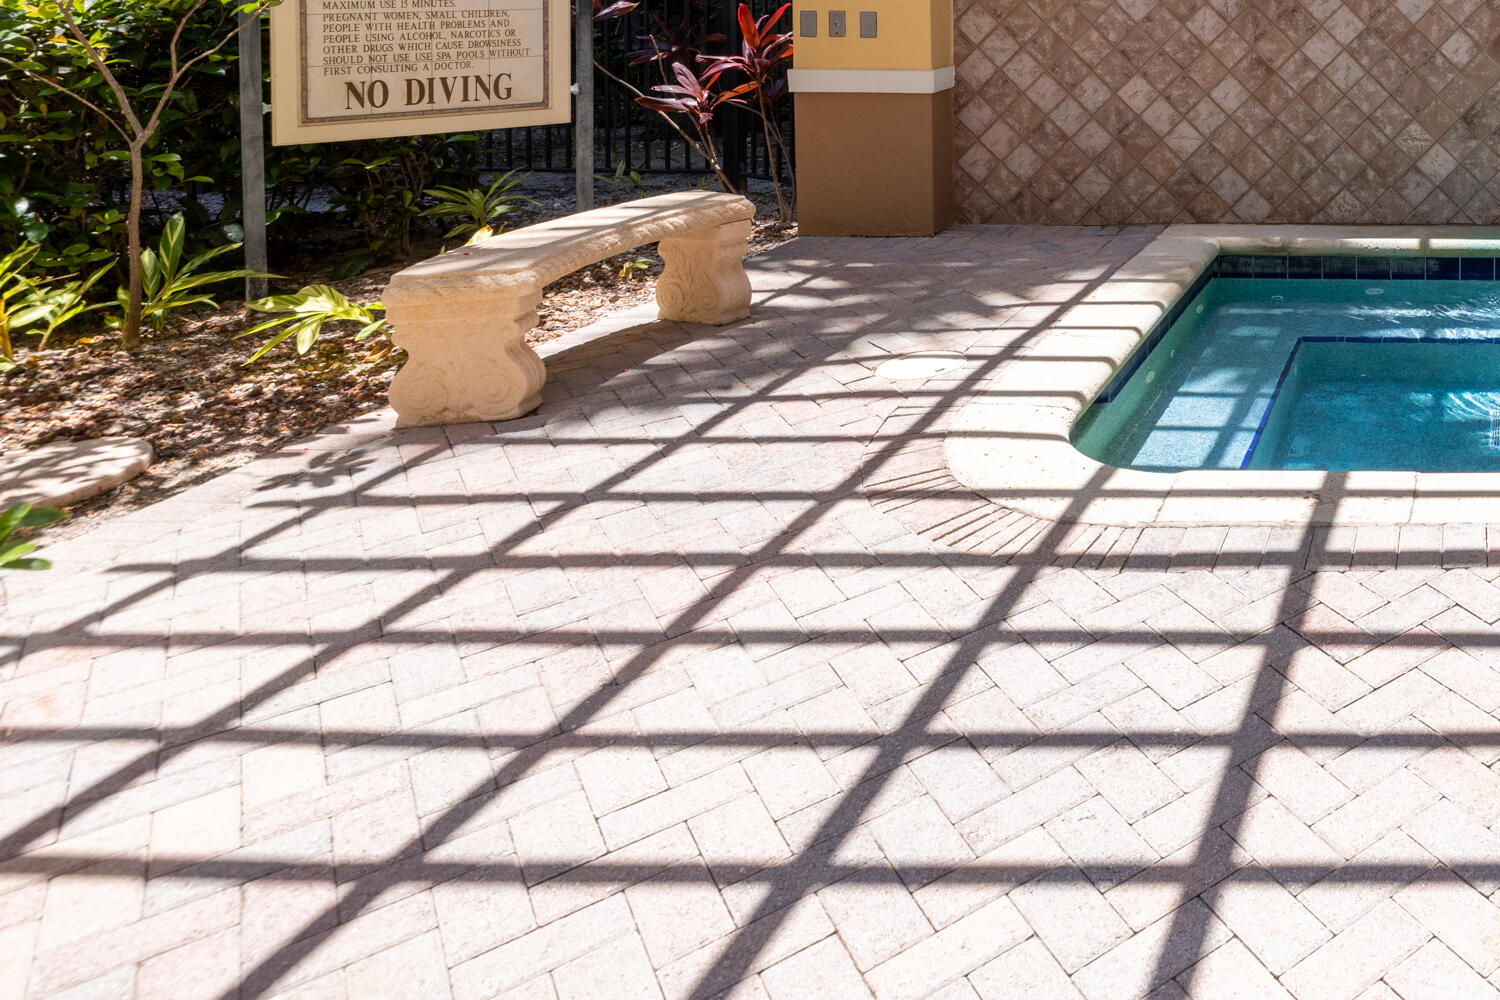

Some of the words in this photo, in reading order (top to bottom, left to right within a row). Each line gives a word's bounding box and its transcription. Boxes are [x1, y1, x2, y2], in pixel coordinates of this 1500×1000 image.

[322, 1, 375, 9] MAXIMUM
[401, 0, 408, 8] 15
[323, 13, 377, 21] PREGNANT
[384, 12, 421, 20] WOMEN,
[426, 11, 457, 19] SMALL
[462, 10, 510, 18] CHILDREN,
[323, 24, 360, 32] PEOPLE
[366, 23, 392, 31] WITH
[397, 22, 435, 30] HEALTH
[441, 20, 485, 29] PROBLEMS
[490, 19, 509, 28] AND
[323, 34, 360, 43] PEOPLE
[366, 33, 394, 42] USING
[400, 32, 446, 40] ALCOHOL,
[451, 29, 500, 38] NARCOTICS
[323, 45, 357, 54] OTHER
[364, 44, 393, 52] DRUGS
[398, 43, 431, 51] WHICH
[436, 41, 463, 49] CAUSE
[468, 39, 521, 48] DROWSINESS
[323, 56, 363, 65] SHOULD
[393, 53, 410, 61] USE
[436, 52, 451, 60] SPA
[457, 50, 485, 59] POOLS
[489, 48, 529, 57] WITHOUT
[324, 66, 352, 76] FIRST
[357, 64, 417, 74] CONSULTING
[434, 61, 474, 70] DOCTOR.
[344, 79, 389, 109] NO
[404, 72, 512, 105] DIVING
